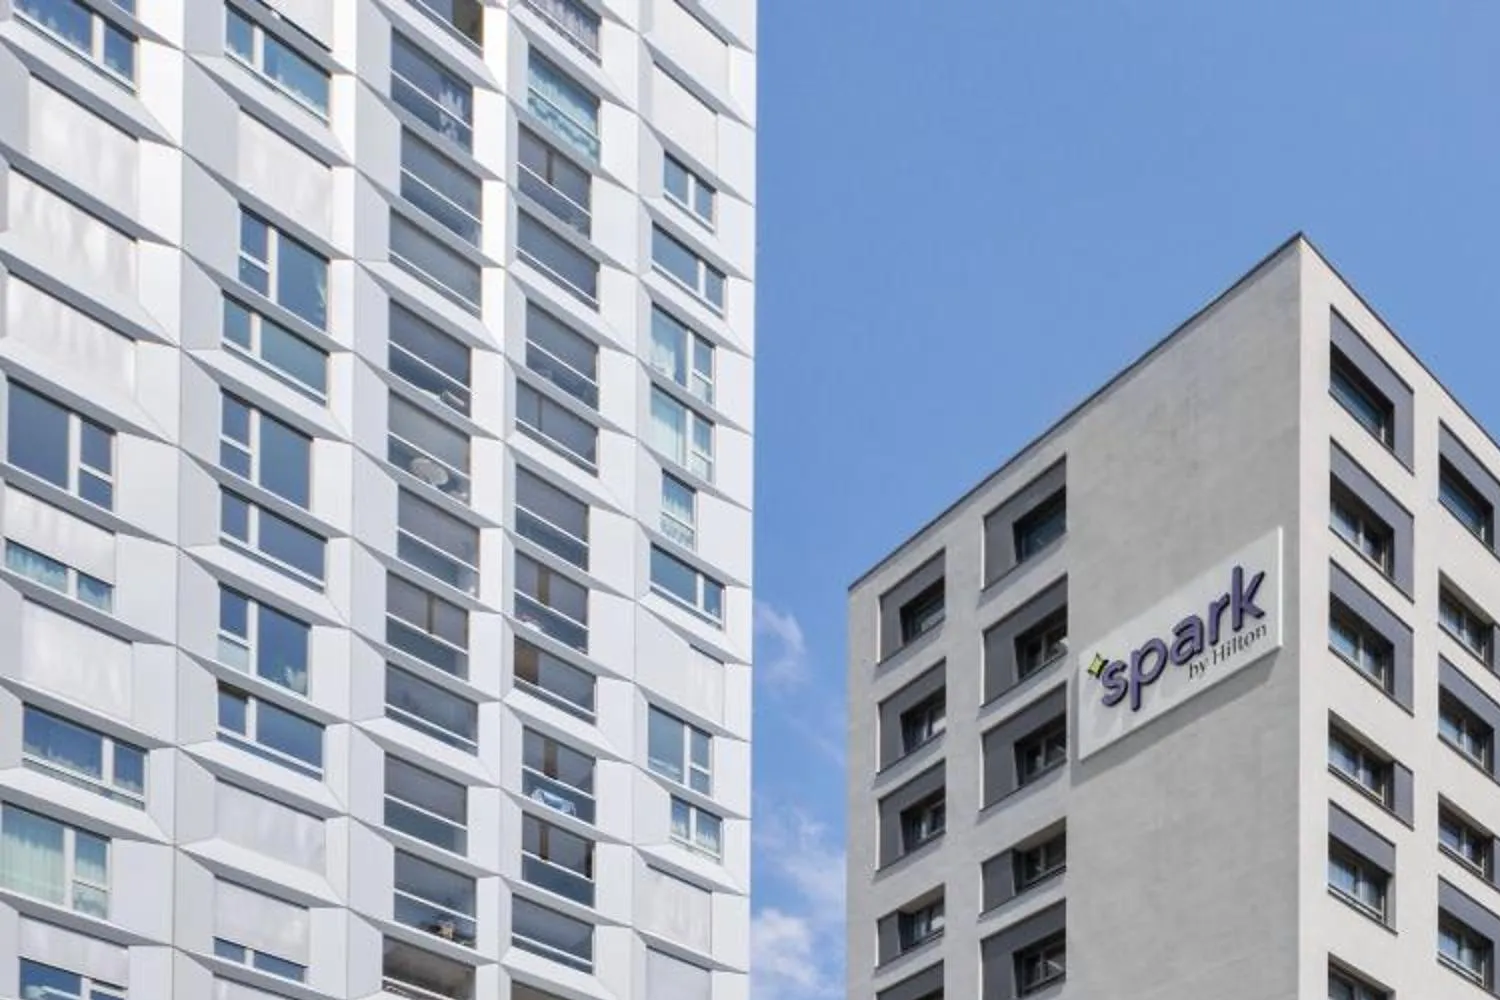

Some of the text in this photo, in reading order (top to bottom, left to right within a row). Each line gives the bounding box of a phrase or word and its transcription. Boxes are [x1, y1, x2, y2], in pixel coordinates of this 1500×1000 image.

[1102, 565, 1266, 712] spark
[1188, 624, 1268, 681] by Hilton
